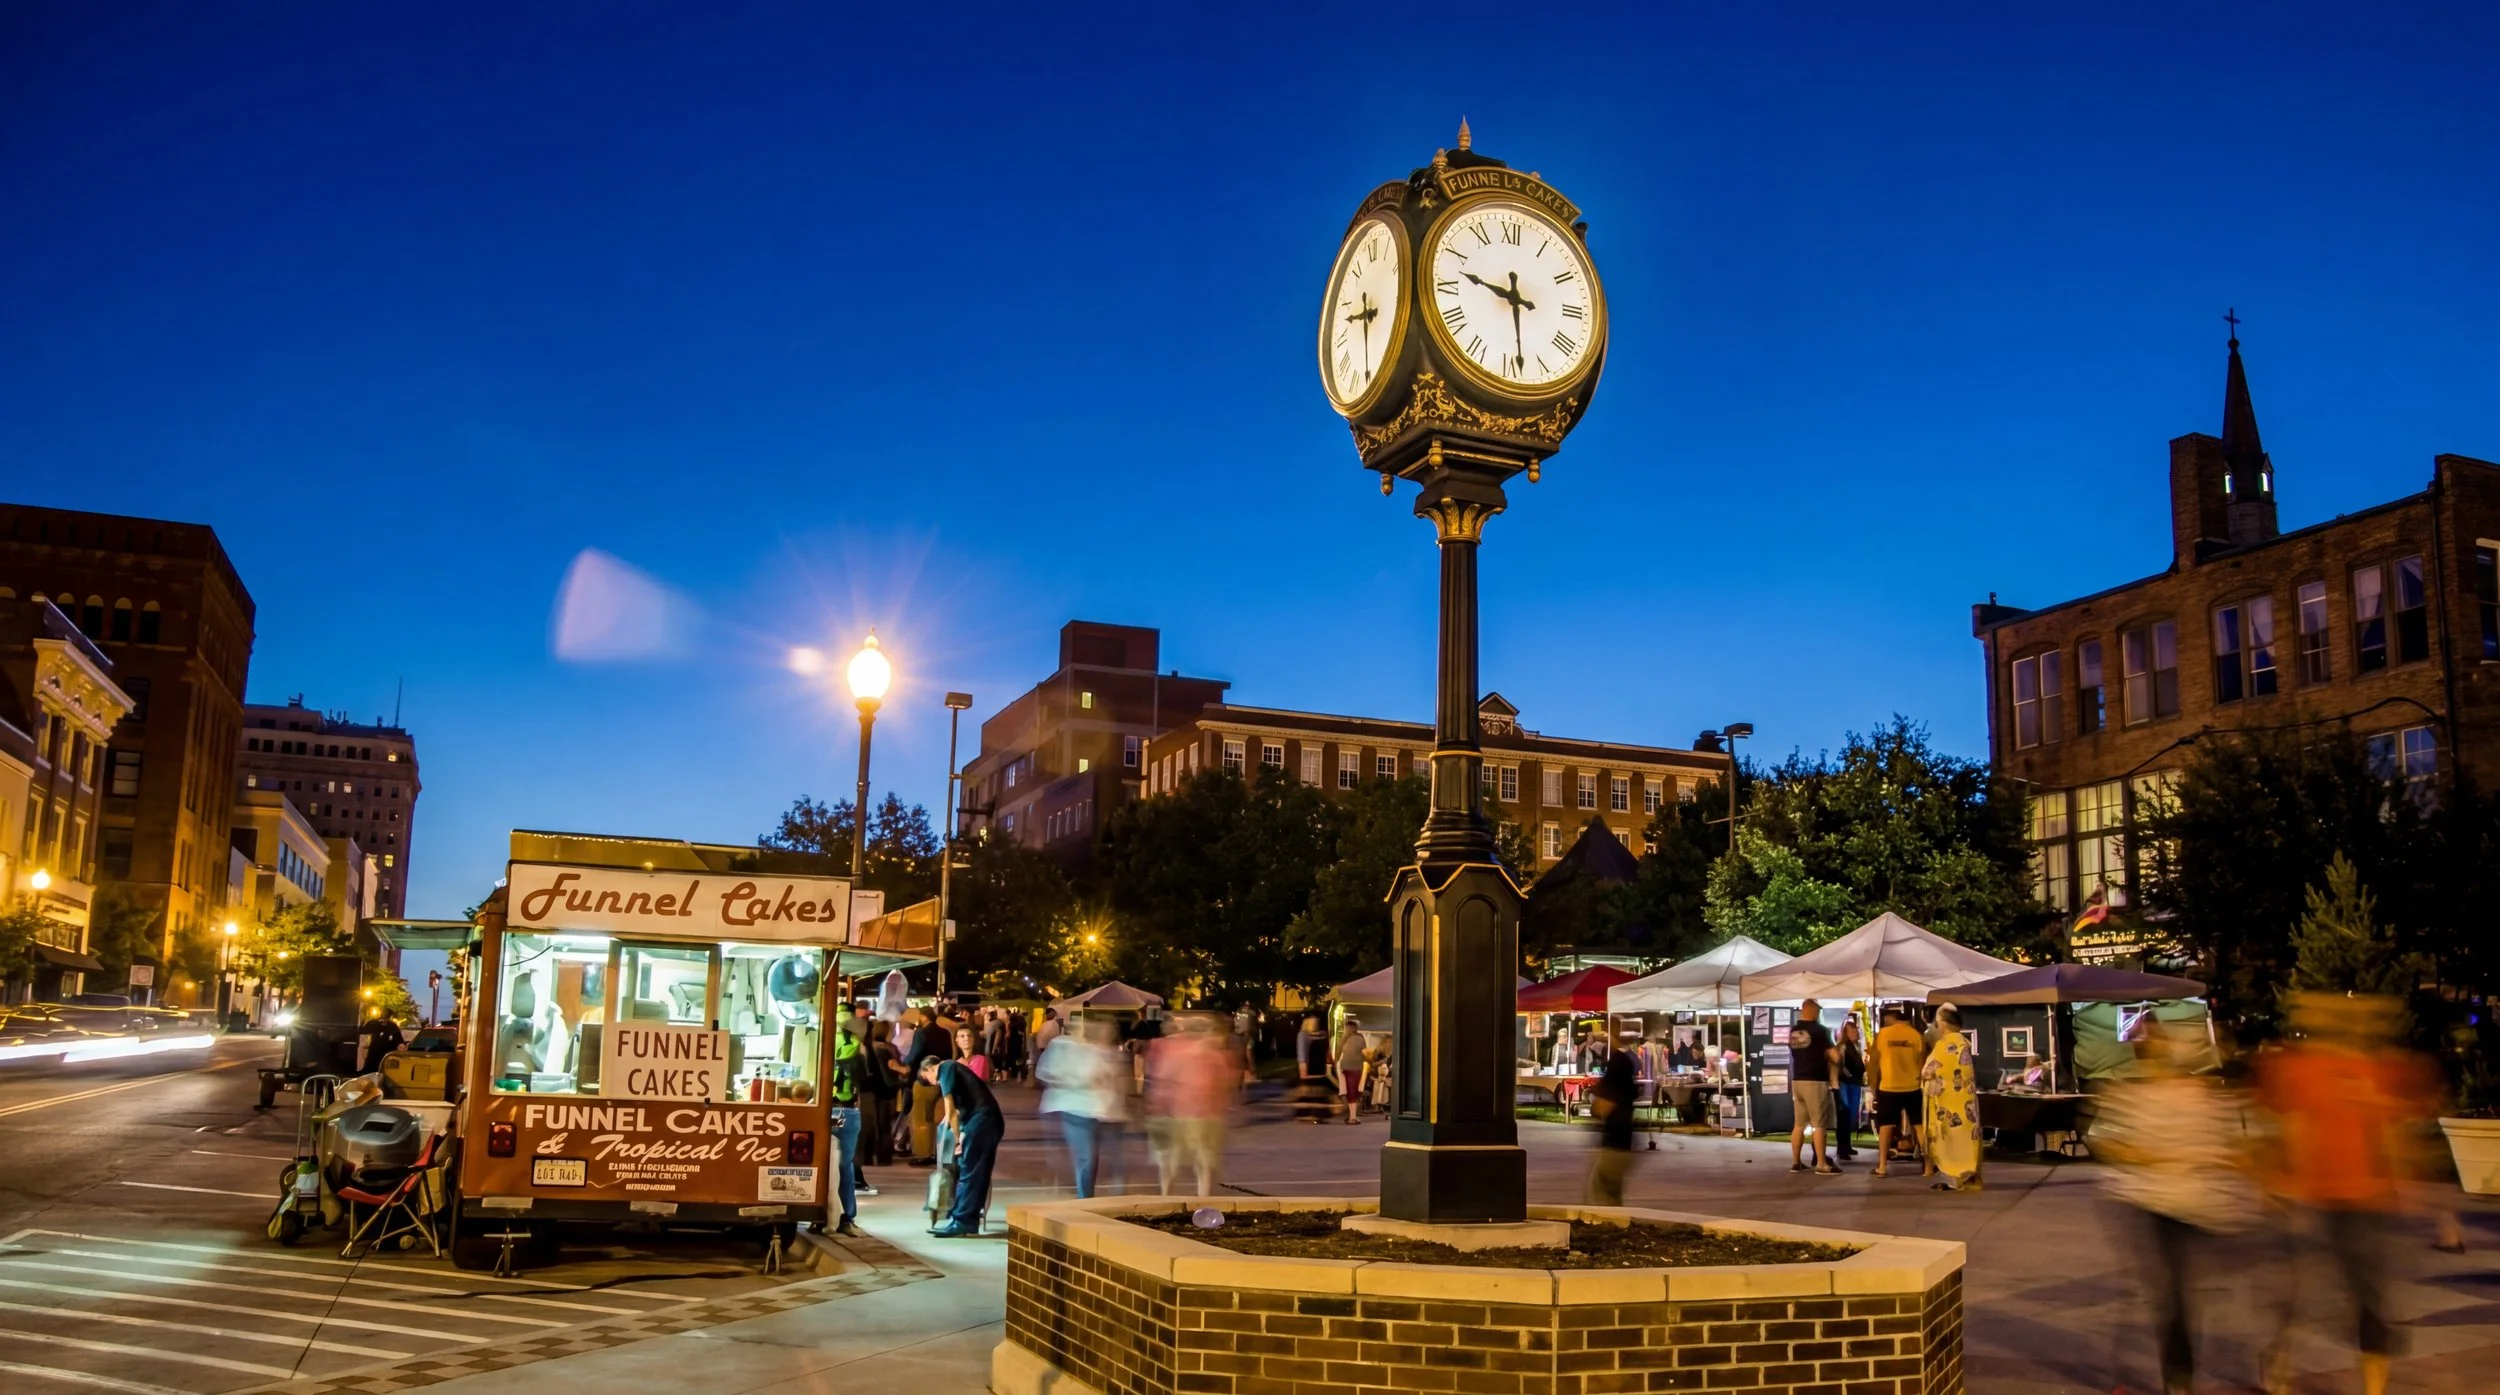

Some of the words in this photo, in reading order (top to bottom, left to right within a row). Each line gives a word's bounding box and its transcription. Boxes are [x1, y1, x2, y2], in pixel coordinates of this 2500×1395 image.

[1501, 221, 1521, 246] XII
[520, 873, 701, 922] Funnel
[720, 881, 837, 926] Cakes
[617, 1030, 723, 1061] FUNNEL
[627, 1068, 711, 1097] CAKES
[524, 1104, 653, 1132] FUNNEL
[665, 1109, 787, 1137] CAKES
[536, 1132, 568, 1155] &
[590, 1134, 729, 1165] Tropical
[735, 1137, 782, 1163] Ice
